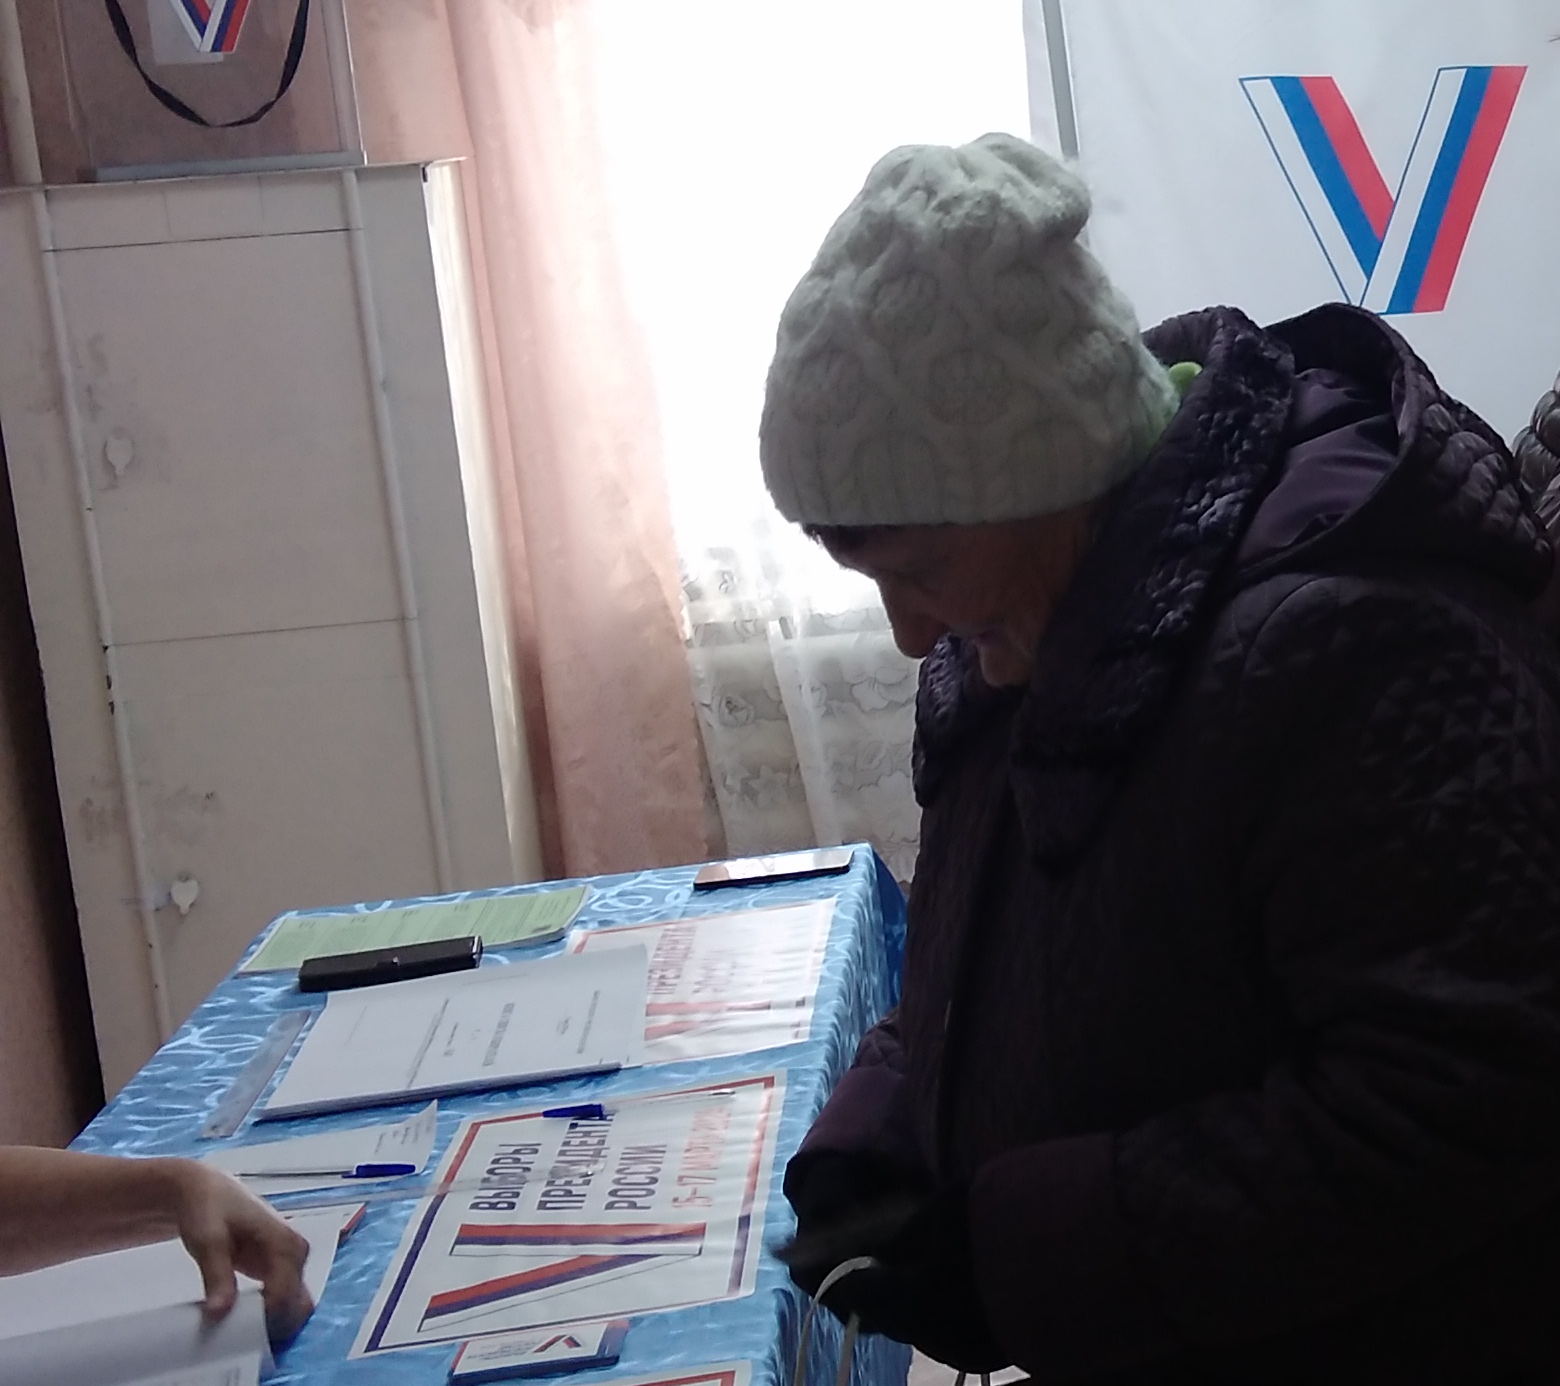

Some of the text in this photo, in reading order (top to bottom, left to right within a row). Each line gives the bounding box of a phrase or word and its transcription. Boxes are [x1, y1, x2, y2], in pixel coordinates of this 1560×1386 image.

[1238, 66, 1528, 315] V
[469, 1142, 542, 1211] ВЫБОРЫ
[536, 1109, 617, 1211] ПРЕИДЕНТА
[604, 1144, 668, 1211] РОССИИ
